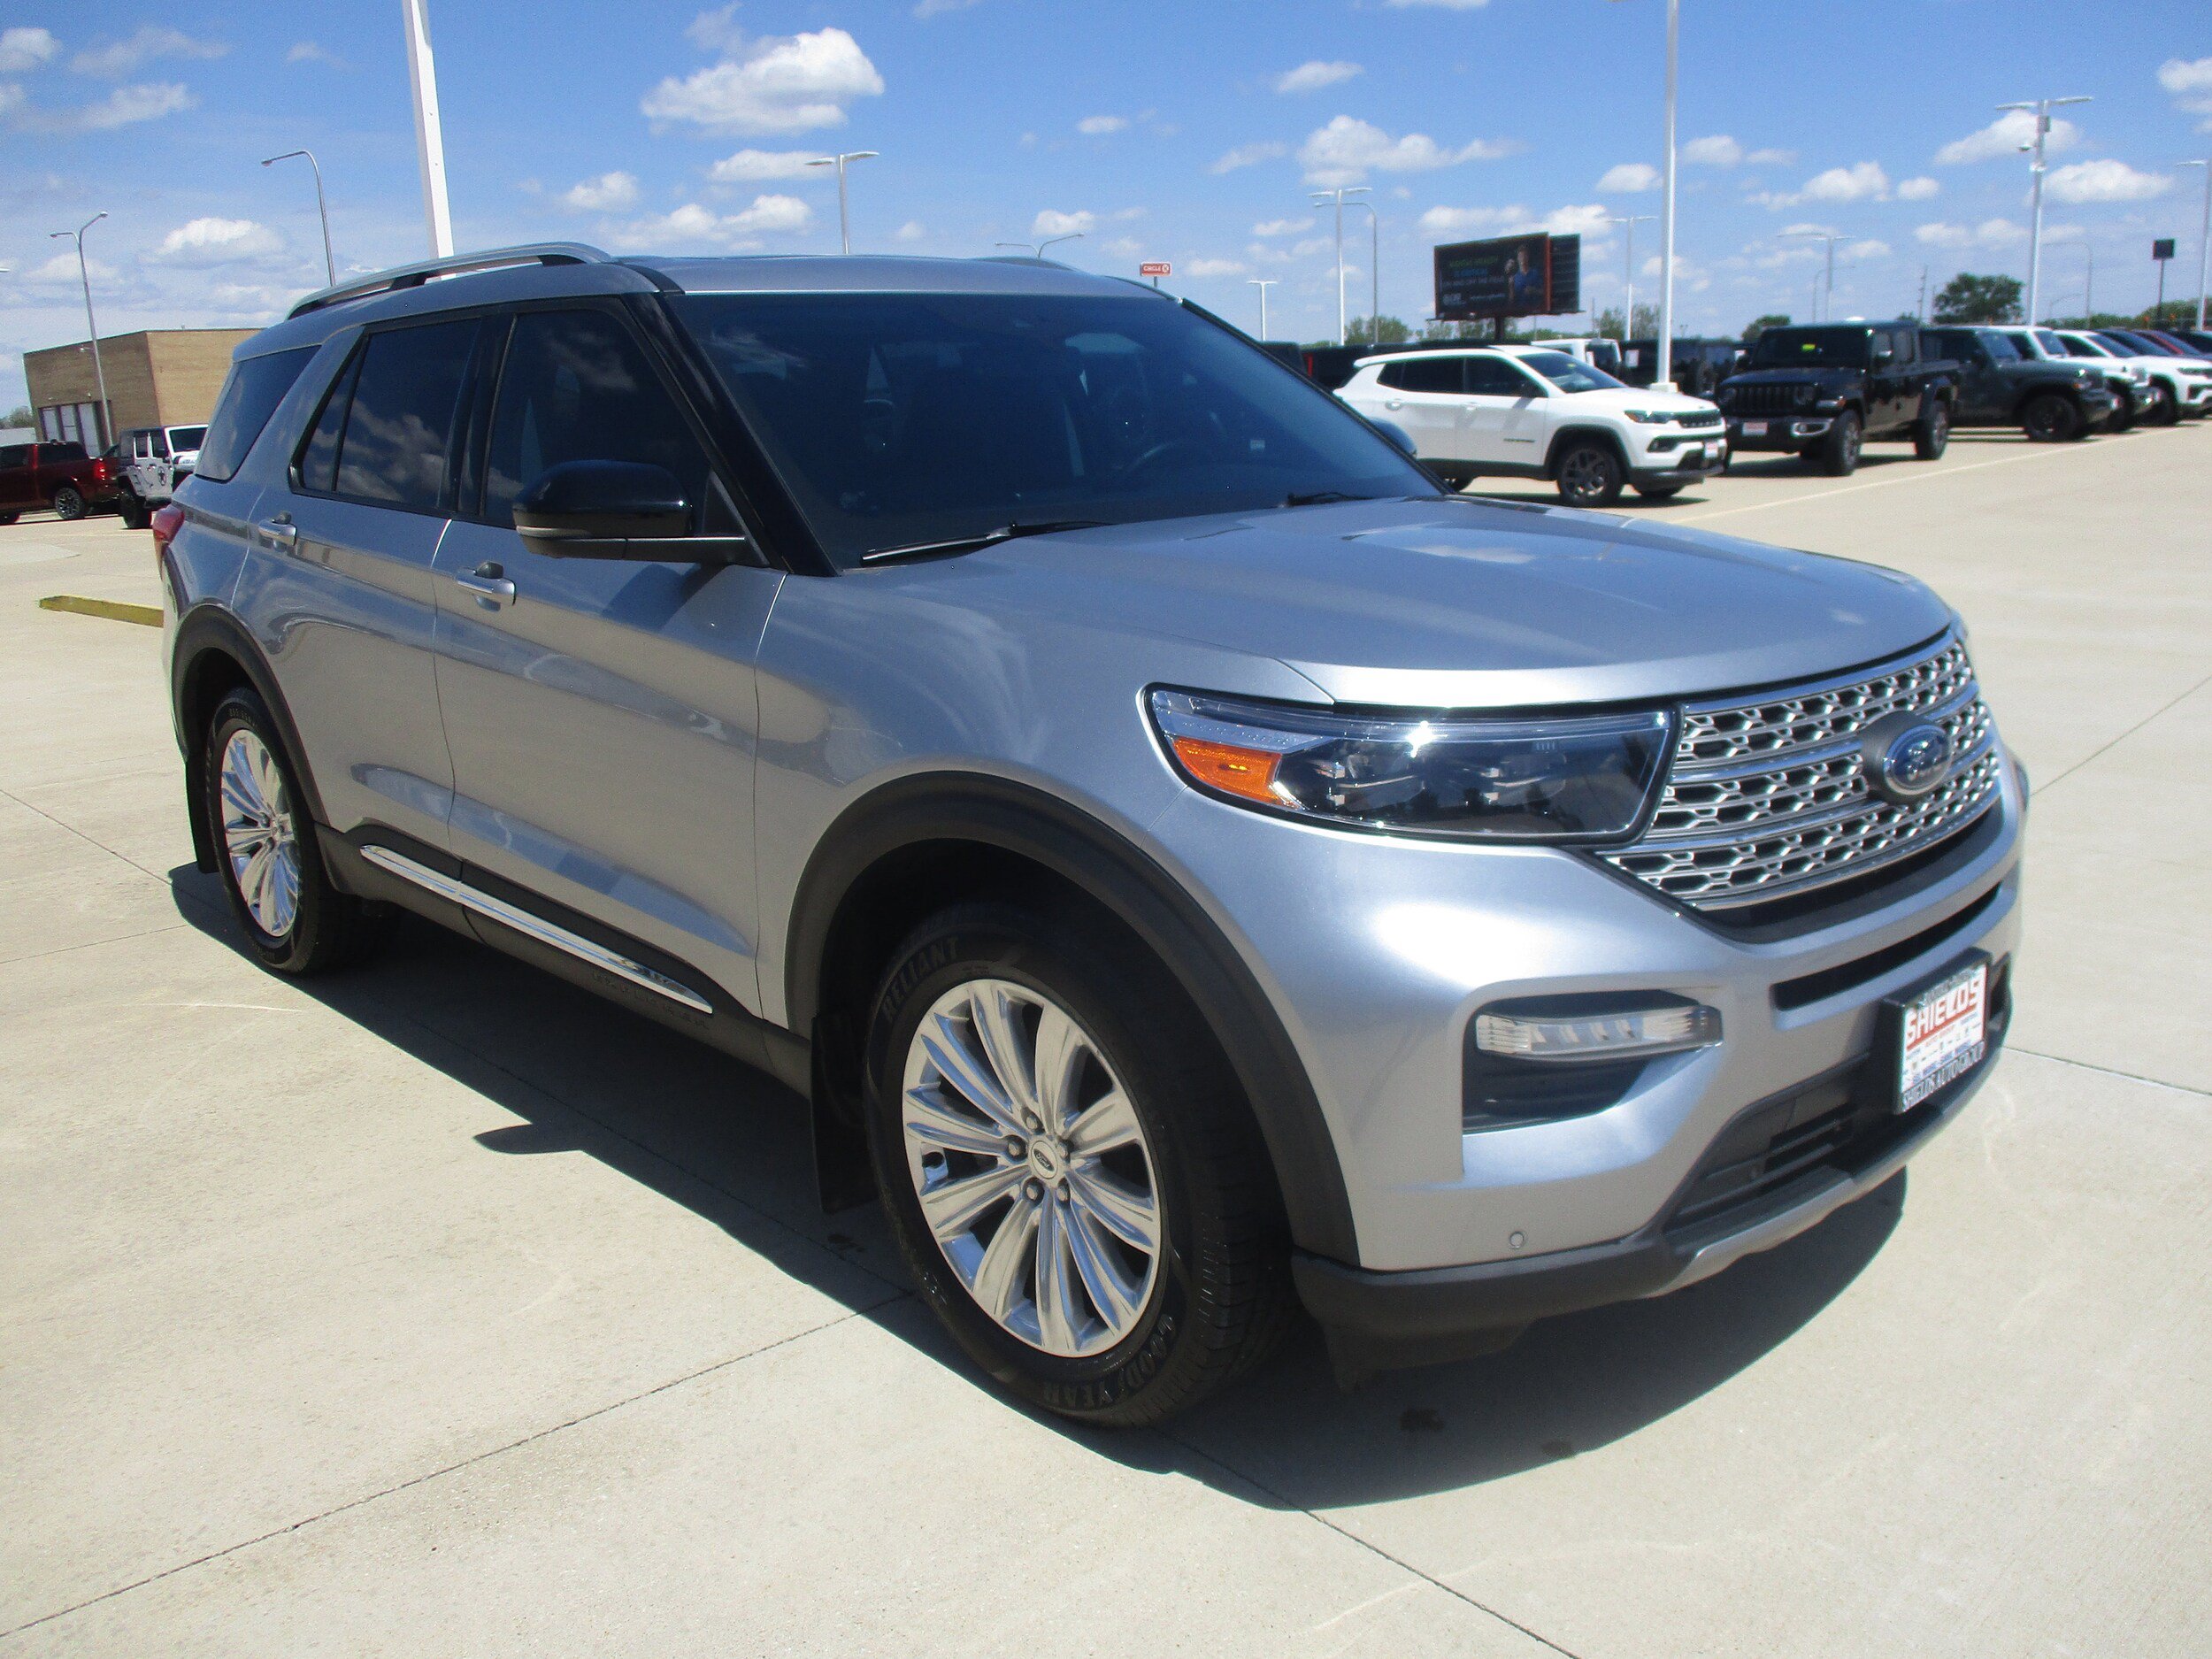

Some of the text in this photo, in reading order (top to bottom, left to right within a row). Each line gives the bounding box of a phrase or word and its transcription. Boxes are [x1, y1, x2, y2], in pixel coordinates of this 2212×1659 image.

[880, 934, 960, 1023] RELIANT
[1906, 978, 1981, 1043] SHIELDS
[1035, 1152, 1051, 1169] Ford
